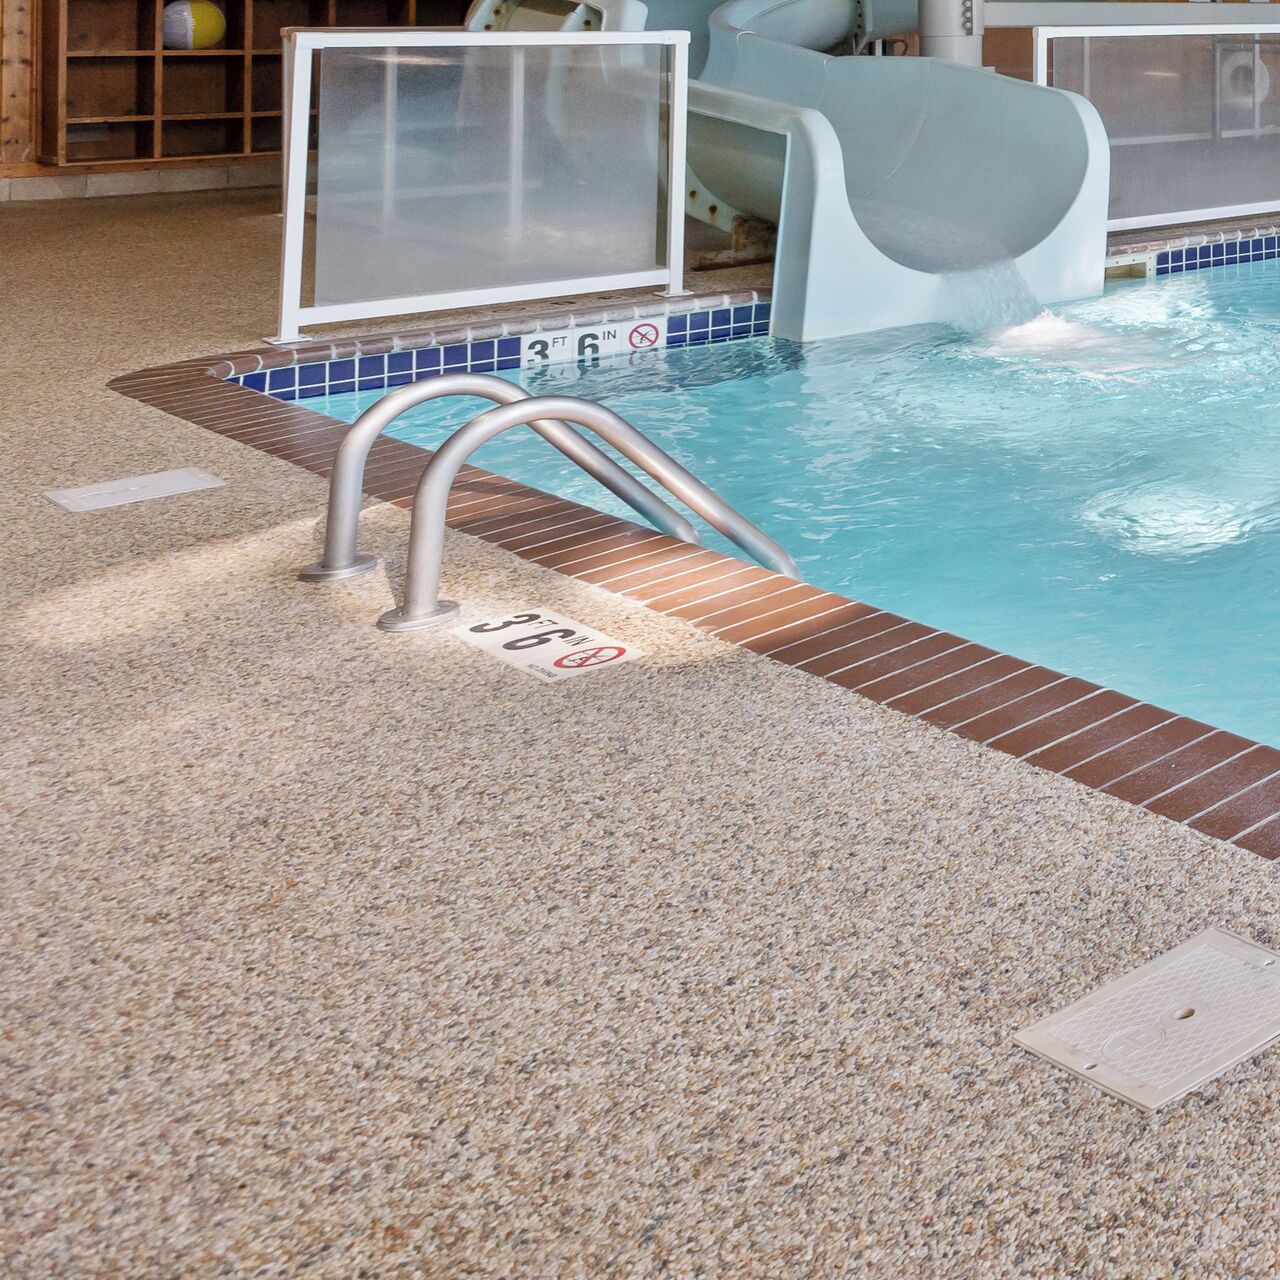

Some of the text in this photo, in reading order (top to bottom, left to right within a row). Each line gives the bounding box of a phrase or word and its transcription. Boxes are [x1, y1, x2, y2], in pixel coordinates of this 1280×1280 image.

[527, 330, 617, 364] 3 FT 6 IN
[469, 613, 594, 651] 3 FT 6 IN
